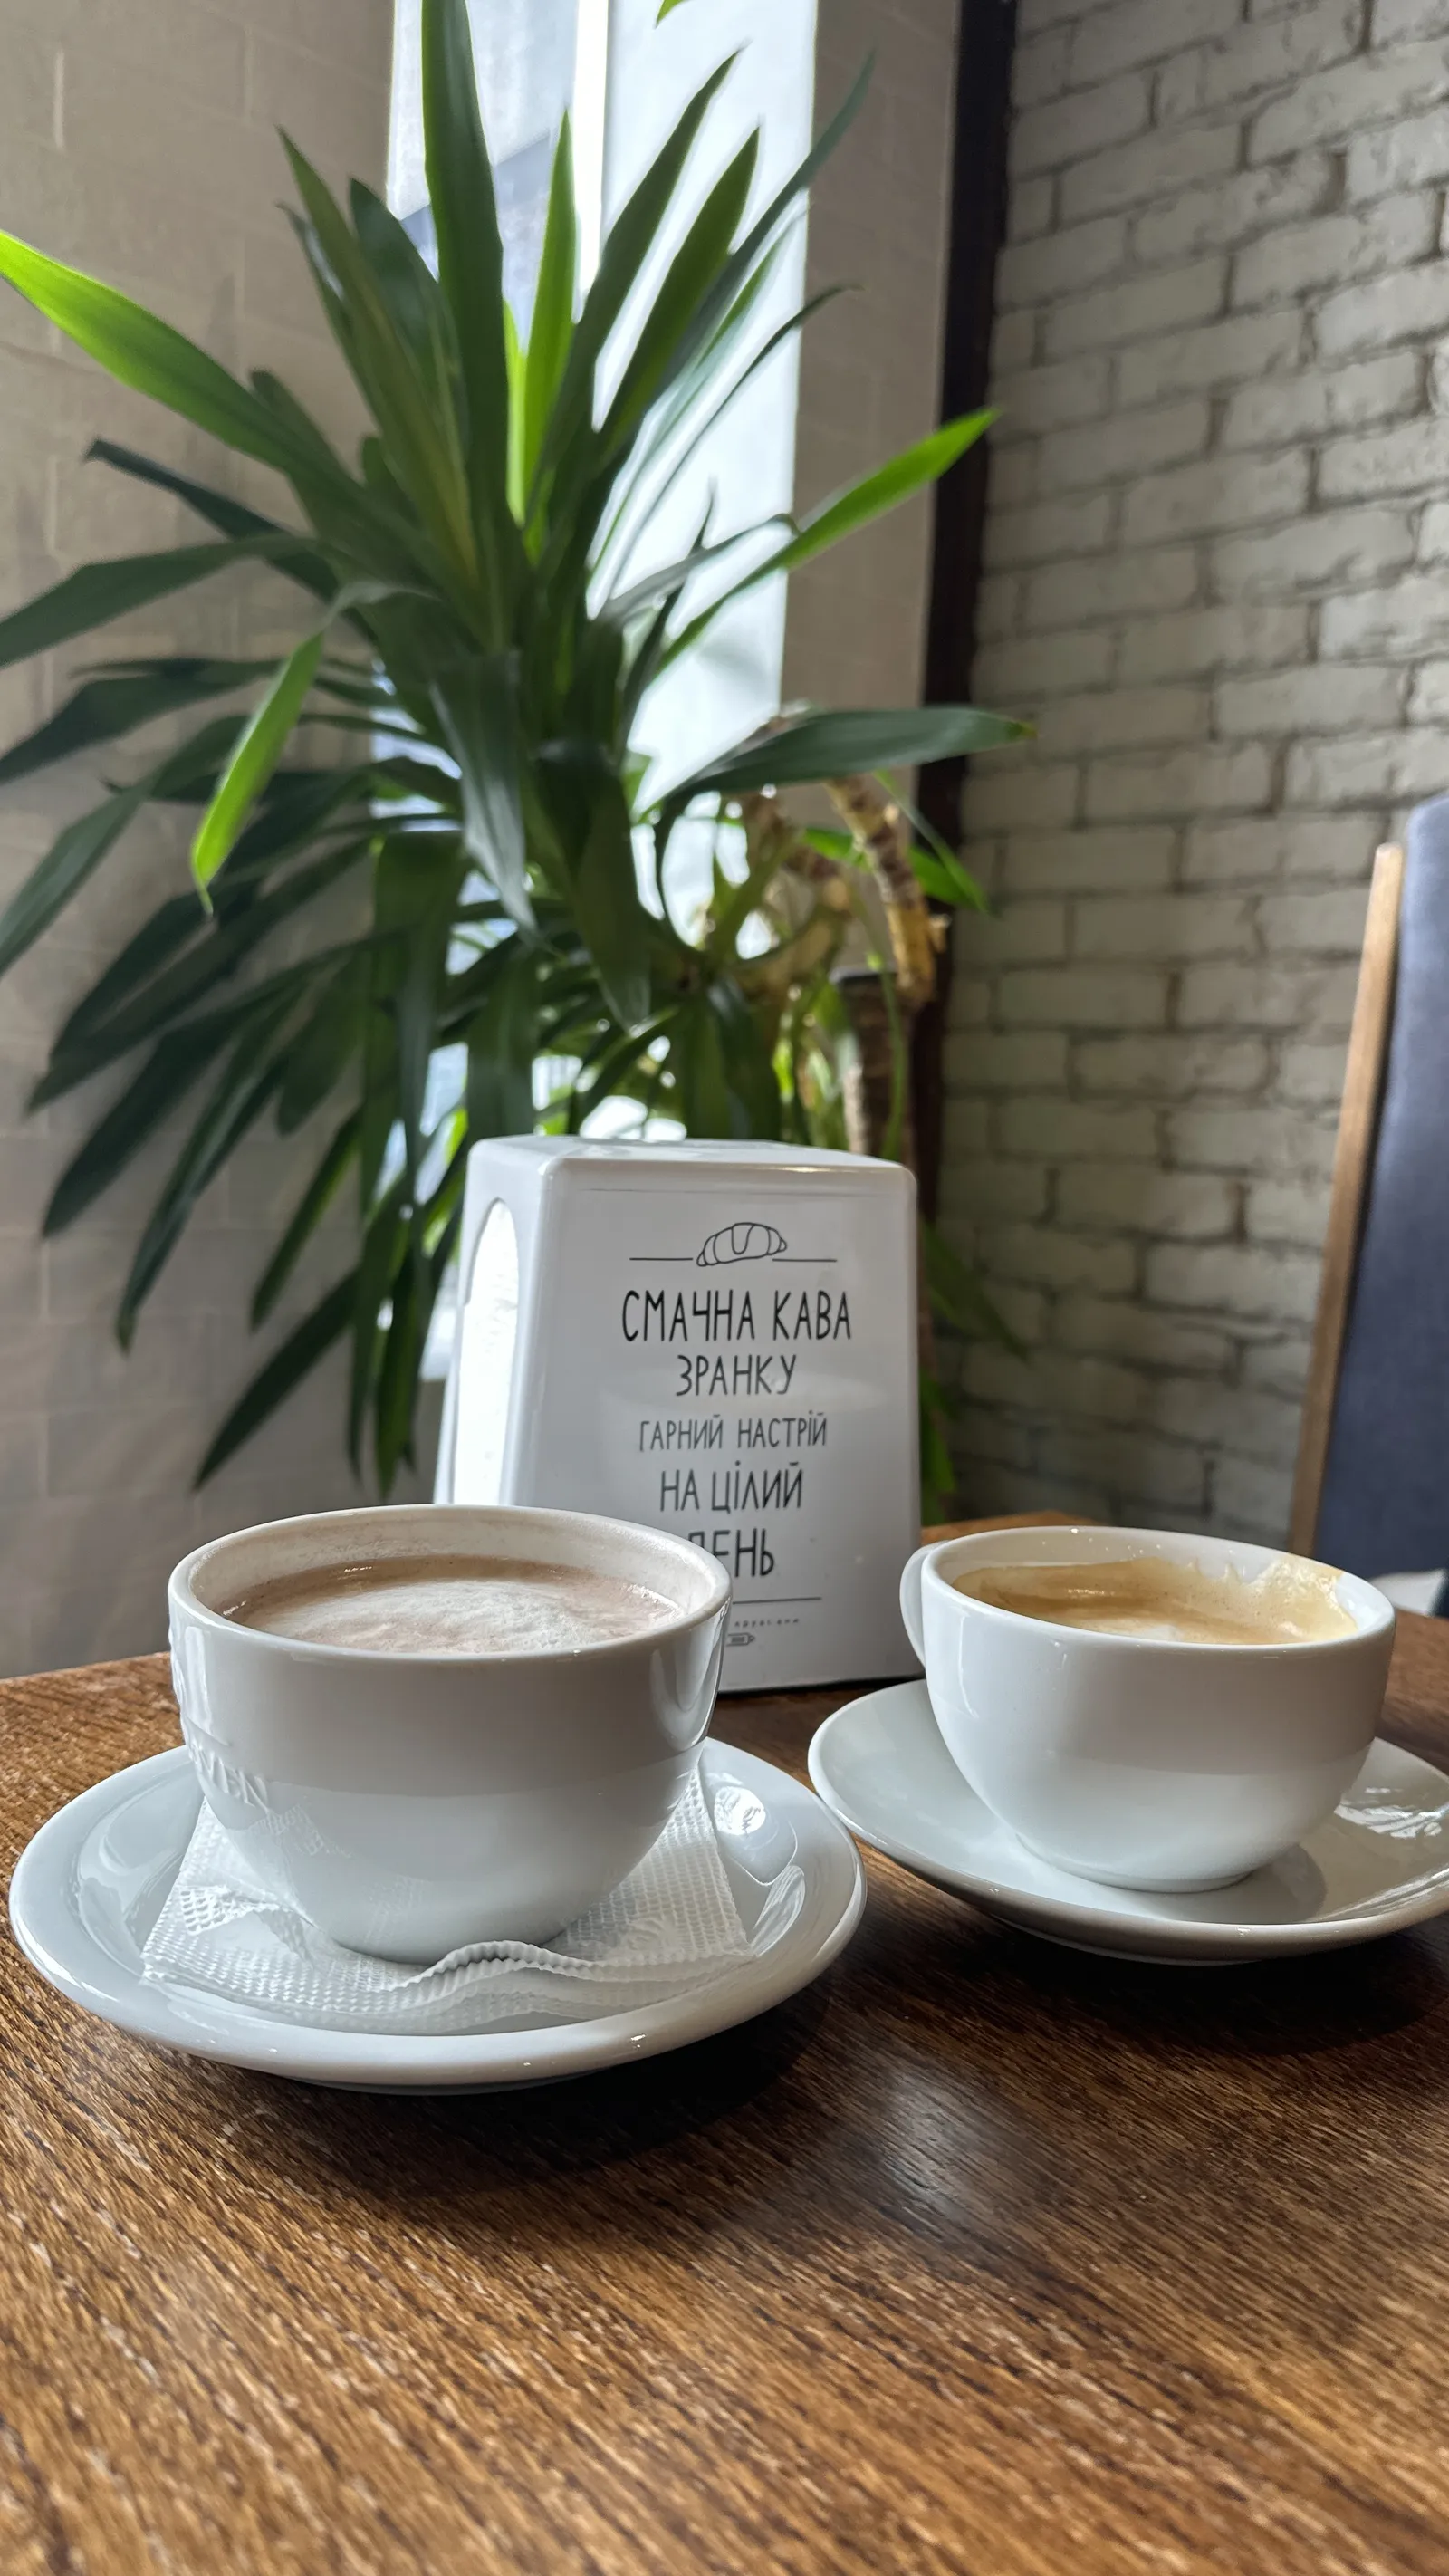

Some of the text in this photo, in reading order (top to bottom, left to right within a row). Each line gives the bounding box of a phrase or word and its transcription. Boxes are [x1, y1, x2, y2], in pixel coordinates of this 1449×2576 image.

[622, 1289, 851, 1342] СМАЧНА КАВА
[676, 1354, 797, 1396] ЗРАНКУ
[639, 1409, 827, 1452] ГАРНИЙ НАСТРІЙ
[659, 1459, 803, 1514] НА ЦІЛИЙ
